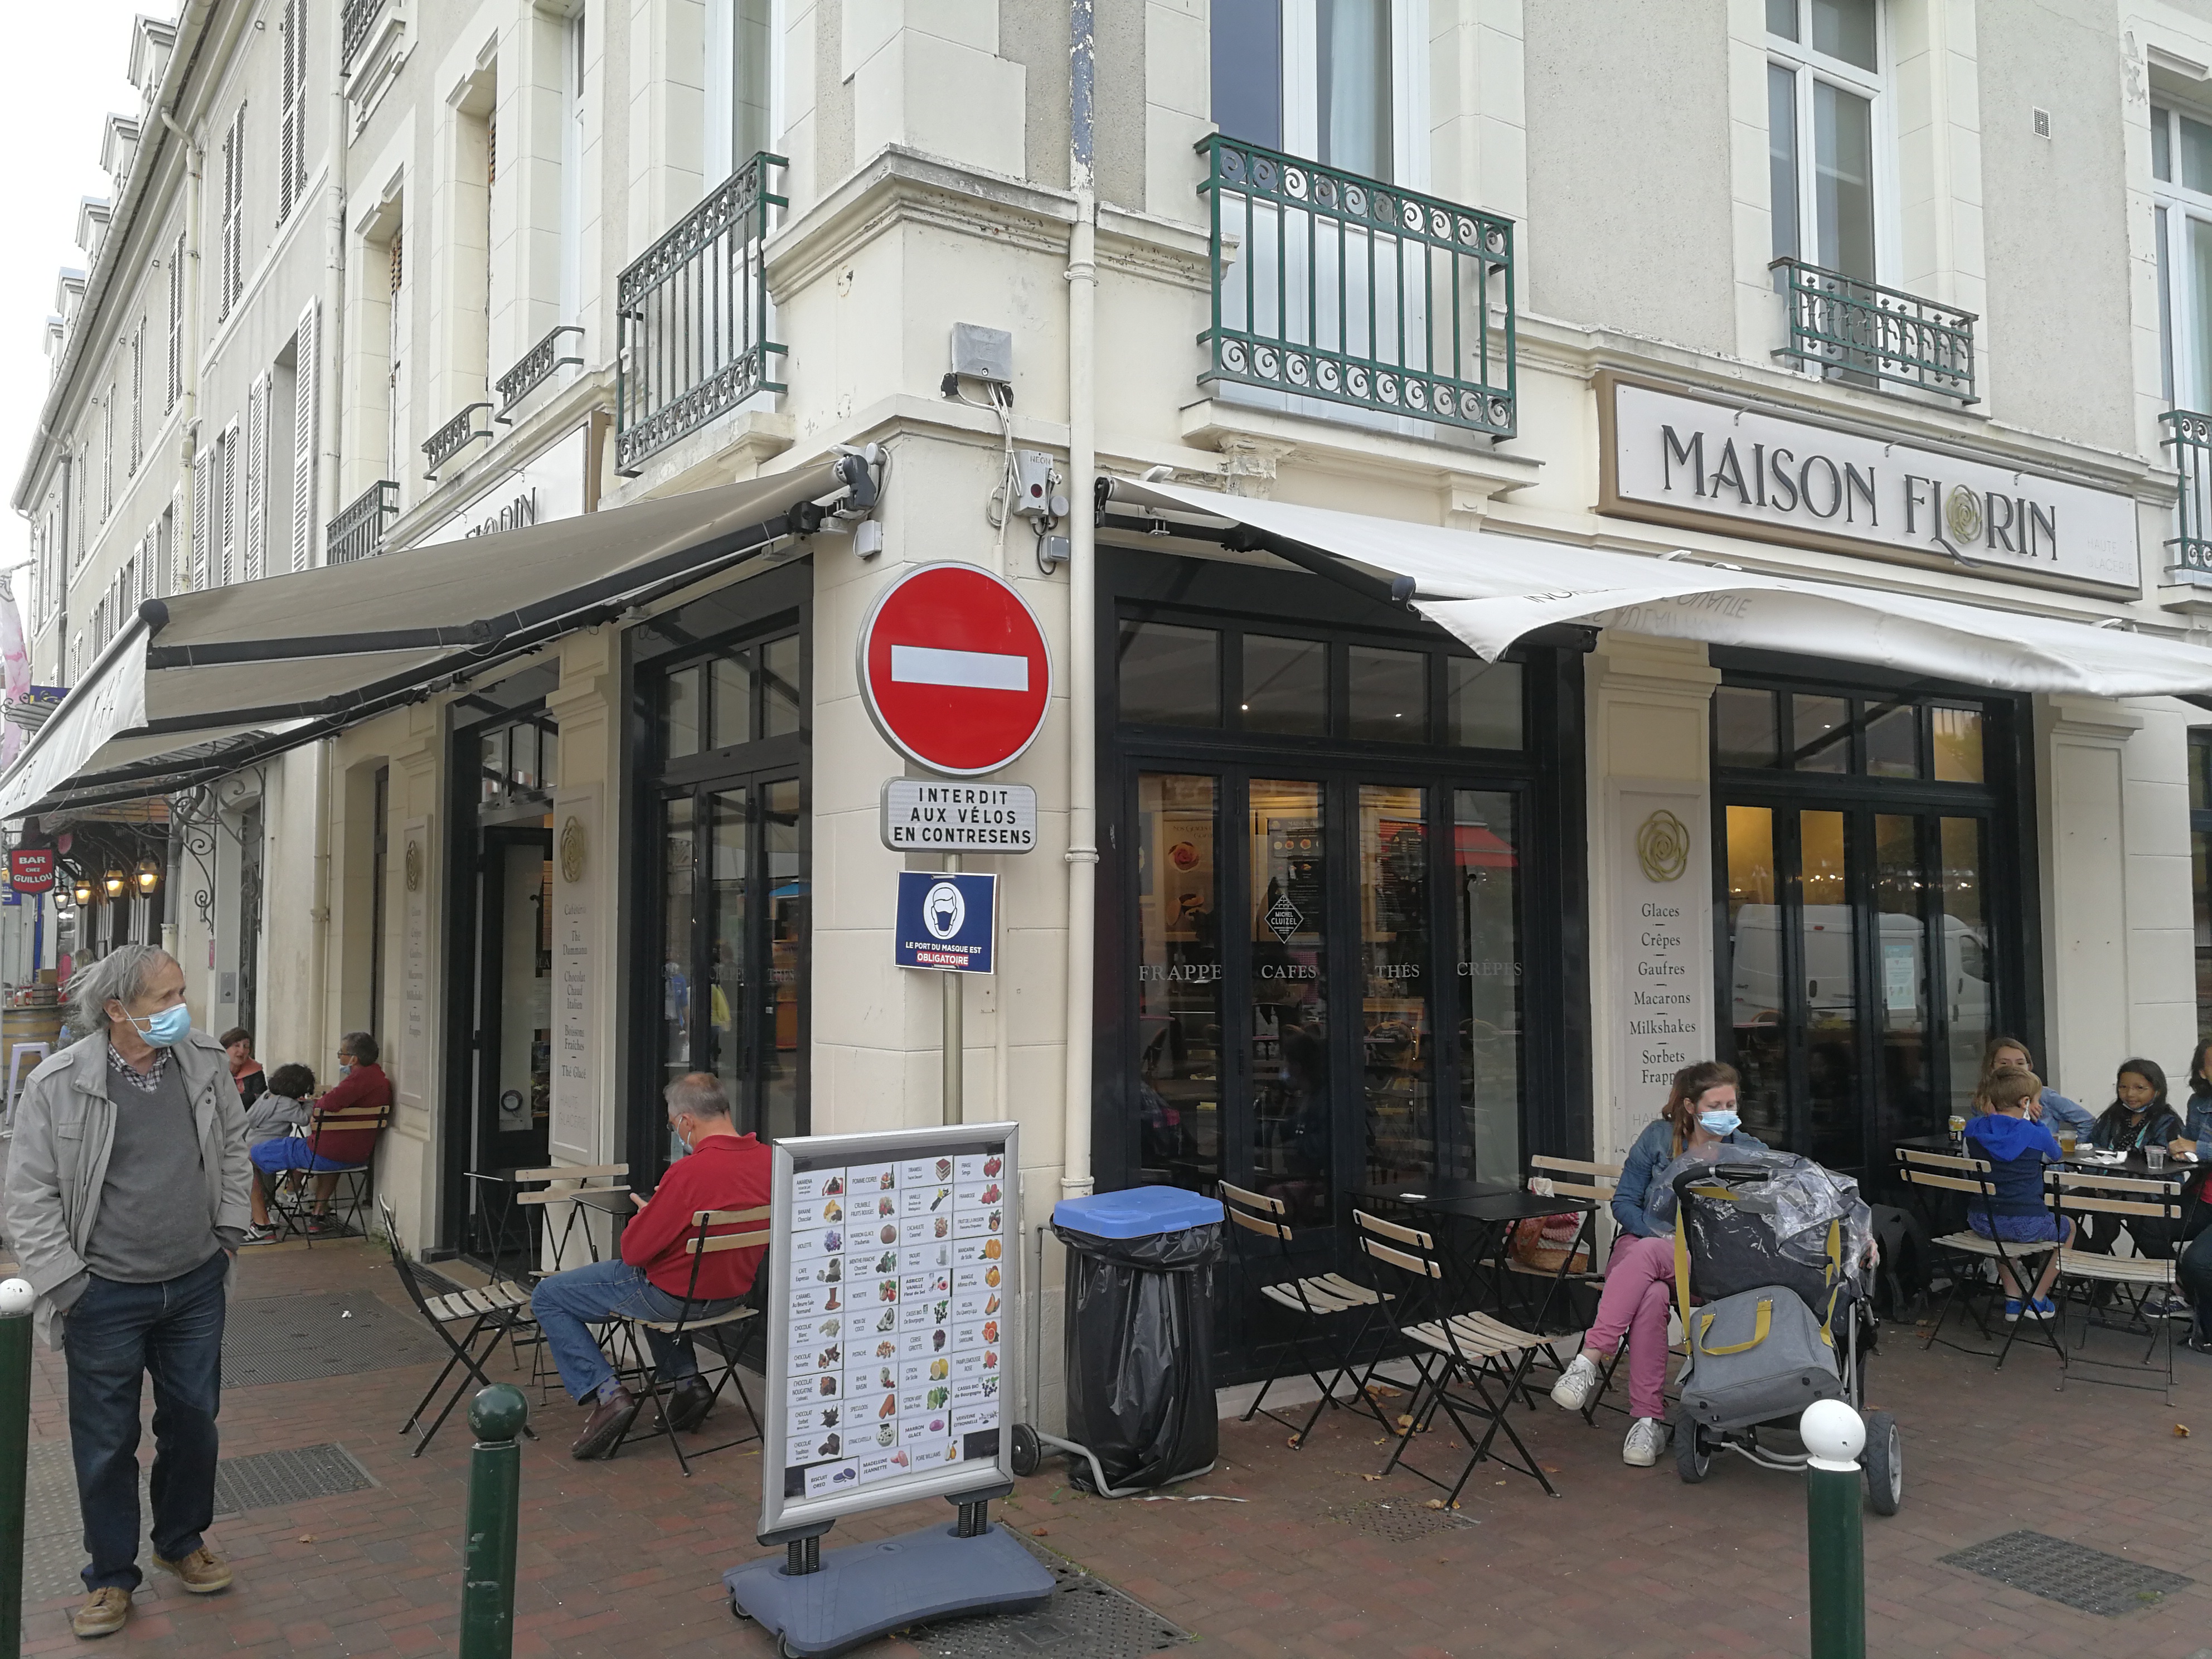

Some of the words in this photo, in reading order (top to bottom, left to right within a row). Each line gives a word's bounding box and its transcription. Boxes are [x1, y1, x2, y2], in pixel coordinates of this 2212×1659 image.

[1661, 424, 1880, 527] MAISON
[1903, 473, 2059, 567] FLORIN
[919, 787, 1007, 805] INTERDIT
[910, 808, 946, 822] AUX
[958, 807, 1016, 824] VÉLOS
[894, 827, 915, 841] EN
[922, 828, 1031, 844] CONTRESENS
[14, 872, 52, 883] GUILLOU
[1642, 903, 1680, 918] Glaces
[915, 942, 930, 950] PORT
[942, 944, 968, 953] MASQUE
[1641, 932, 1681, 949] Crêpes
[917, 953, 968, 965] OBLIGATOIRE
[1262, 964, 1317, 979] CAFES
[1375, 963, 1420, 978] THÉS
[1457, 959, 1522, 976] CRÊPES
[1638, 961, 1685, 976] Gaufres
[1633, 991, 1690, 1005] Macarons
[1629, 1018, 1696, 1035] Milkshakes
[1642, 1049, 1685, 1064] Sorbets
[562, 1065, 571, 1077] Thé
[1642, 1069, 1675, 1085] Frapp
[956, 1356, 981, 1365] PAMPLEMOUSSE
[905, 1424, 924, 1433] MARRON
[954, 1419, 978, 1428] CITRONNELLE
[848, 1436, 871, 1445] STRACCIATELLA
[863, 1458, 887, 1467] MADELEINE
[925, 1451, 941, 1460] WILLIAMS
[864, 1465, 887, 1474] JEANNETTE
[811, 1474, 827, 1483] BISCUIT
